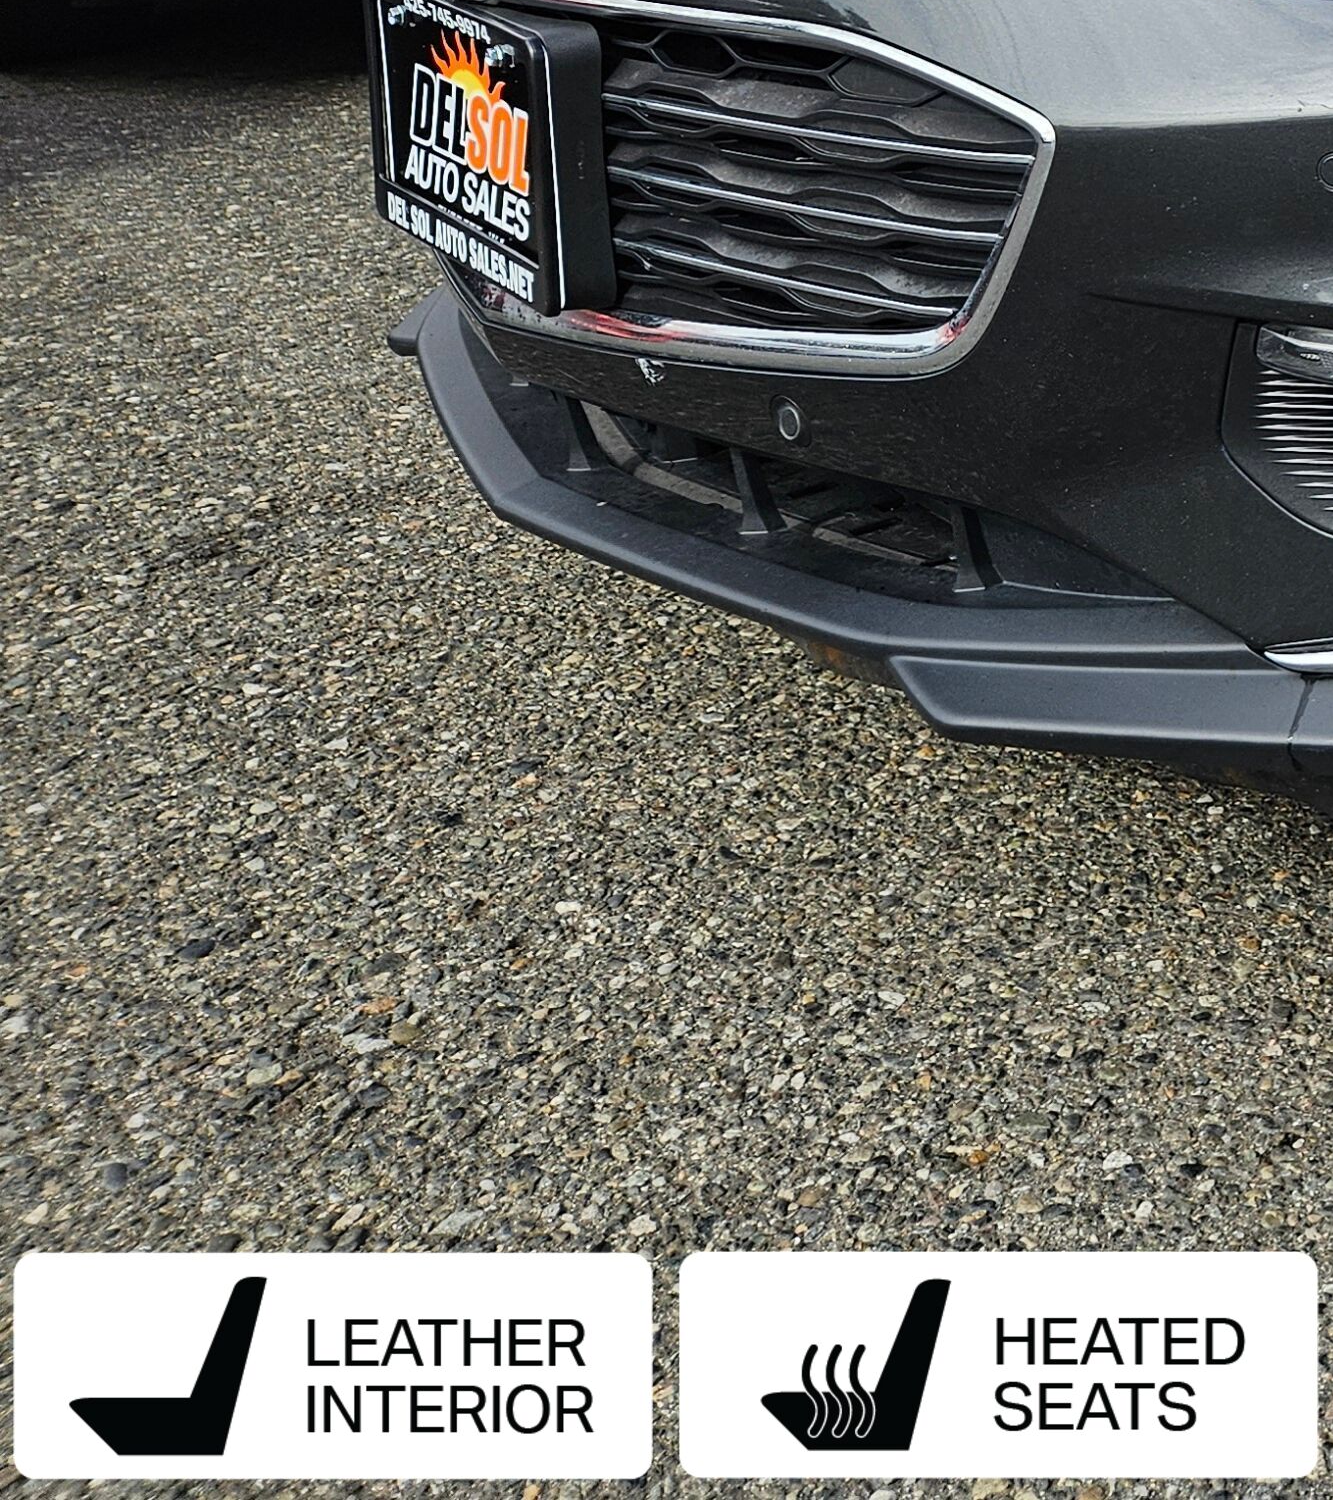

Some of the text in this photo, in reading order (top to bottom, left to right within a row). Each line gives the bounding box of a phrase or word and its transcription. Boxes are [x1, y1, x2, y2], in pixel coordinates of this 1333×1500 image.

[404, 144, 459, 203] AUTO
[461, 172, 531, 242] SALES
[387, 191, 409, 230] DEL
[410, 204, 434, 245] SOL
[434, 218, 467, 264] AUTO
[468, 237, 534, 303] SALES.NET
